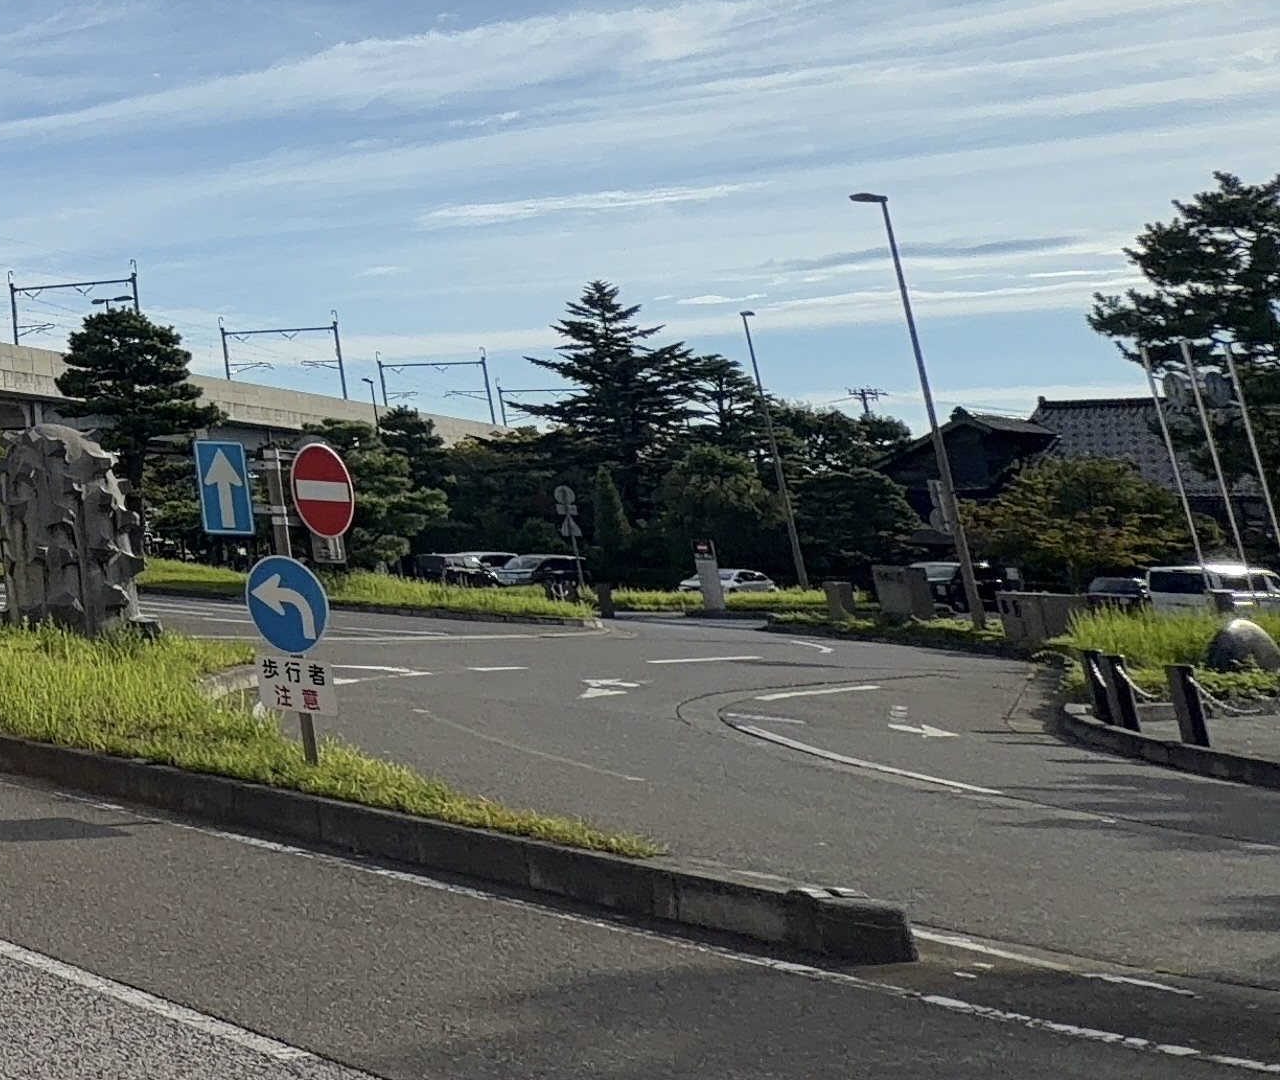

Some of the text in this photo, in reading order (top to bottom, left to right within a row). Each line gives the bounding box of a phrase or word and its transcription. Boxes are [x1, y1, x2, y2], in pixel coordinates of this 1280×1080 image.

[262, 658, 326, 686] 歩行者
[274, 684, 321, 712] 注意
